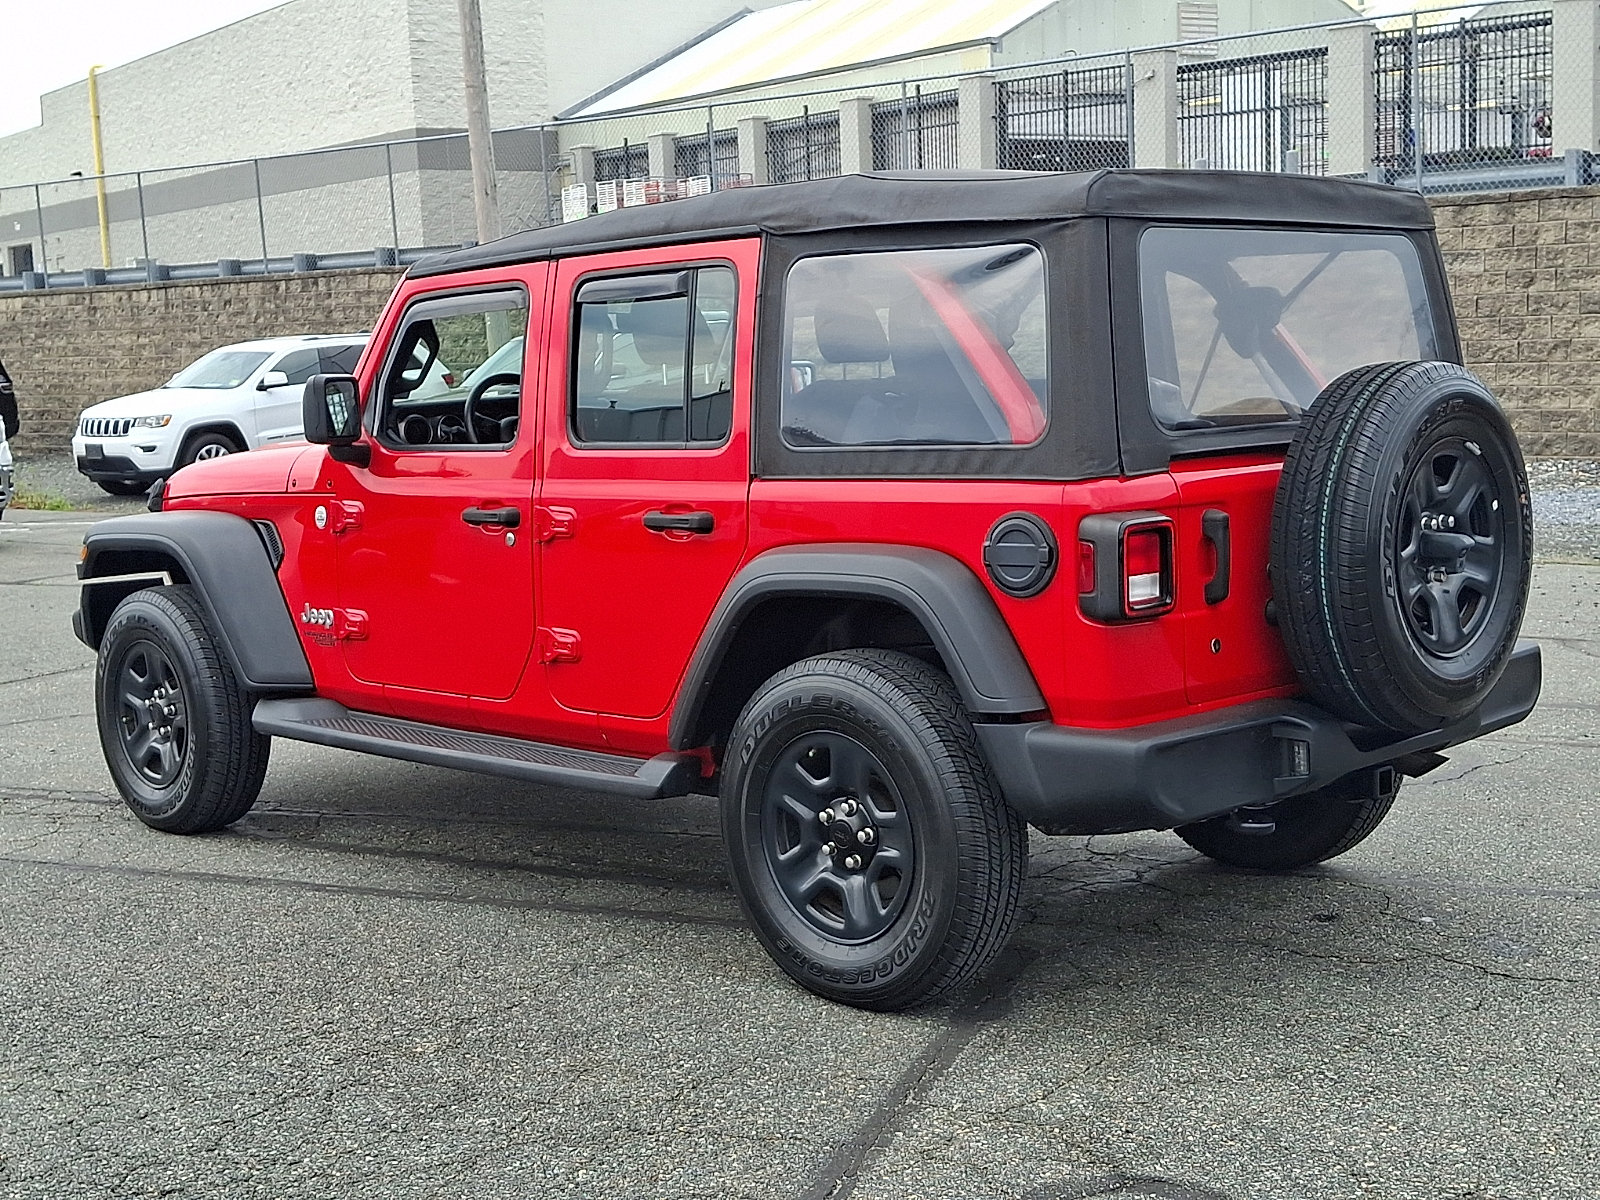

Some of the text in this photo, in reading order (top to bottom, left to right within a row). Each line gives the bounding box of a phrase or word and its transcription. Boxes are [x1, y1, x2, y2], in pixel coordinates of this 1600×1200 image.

[300, 602, 334, 629] Jeep
[740, 692, 858, 765] DUELER
[775, 889, 937, 984] BRIDGESTONE
